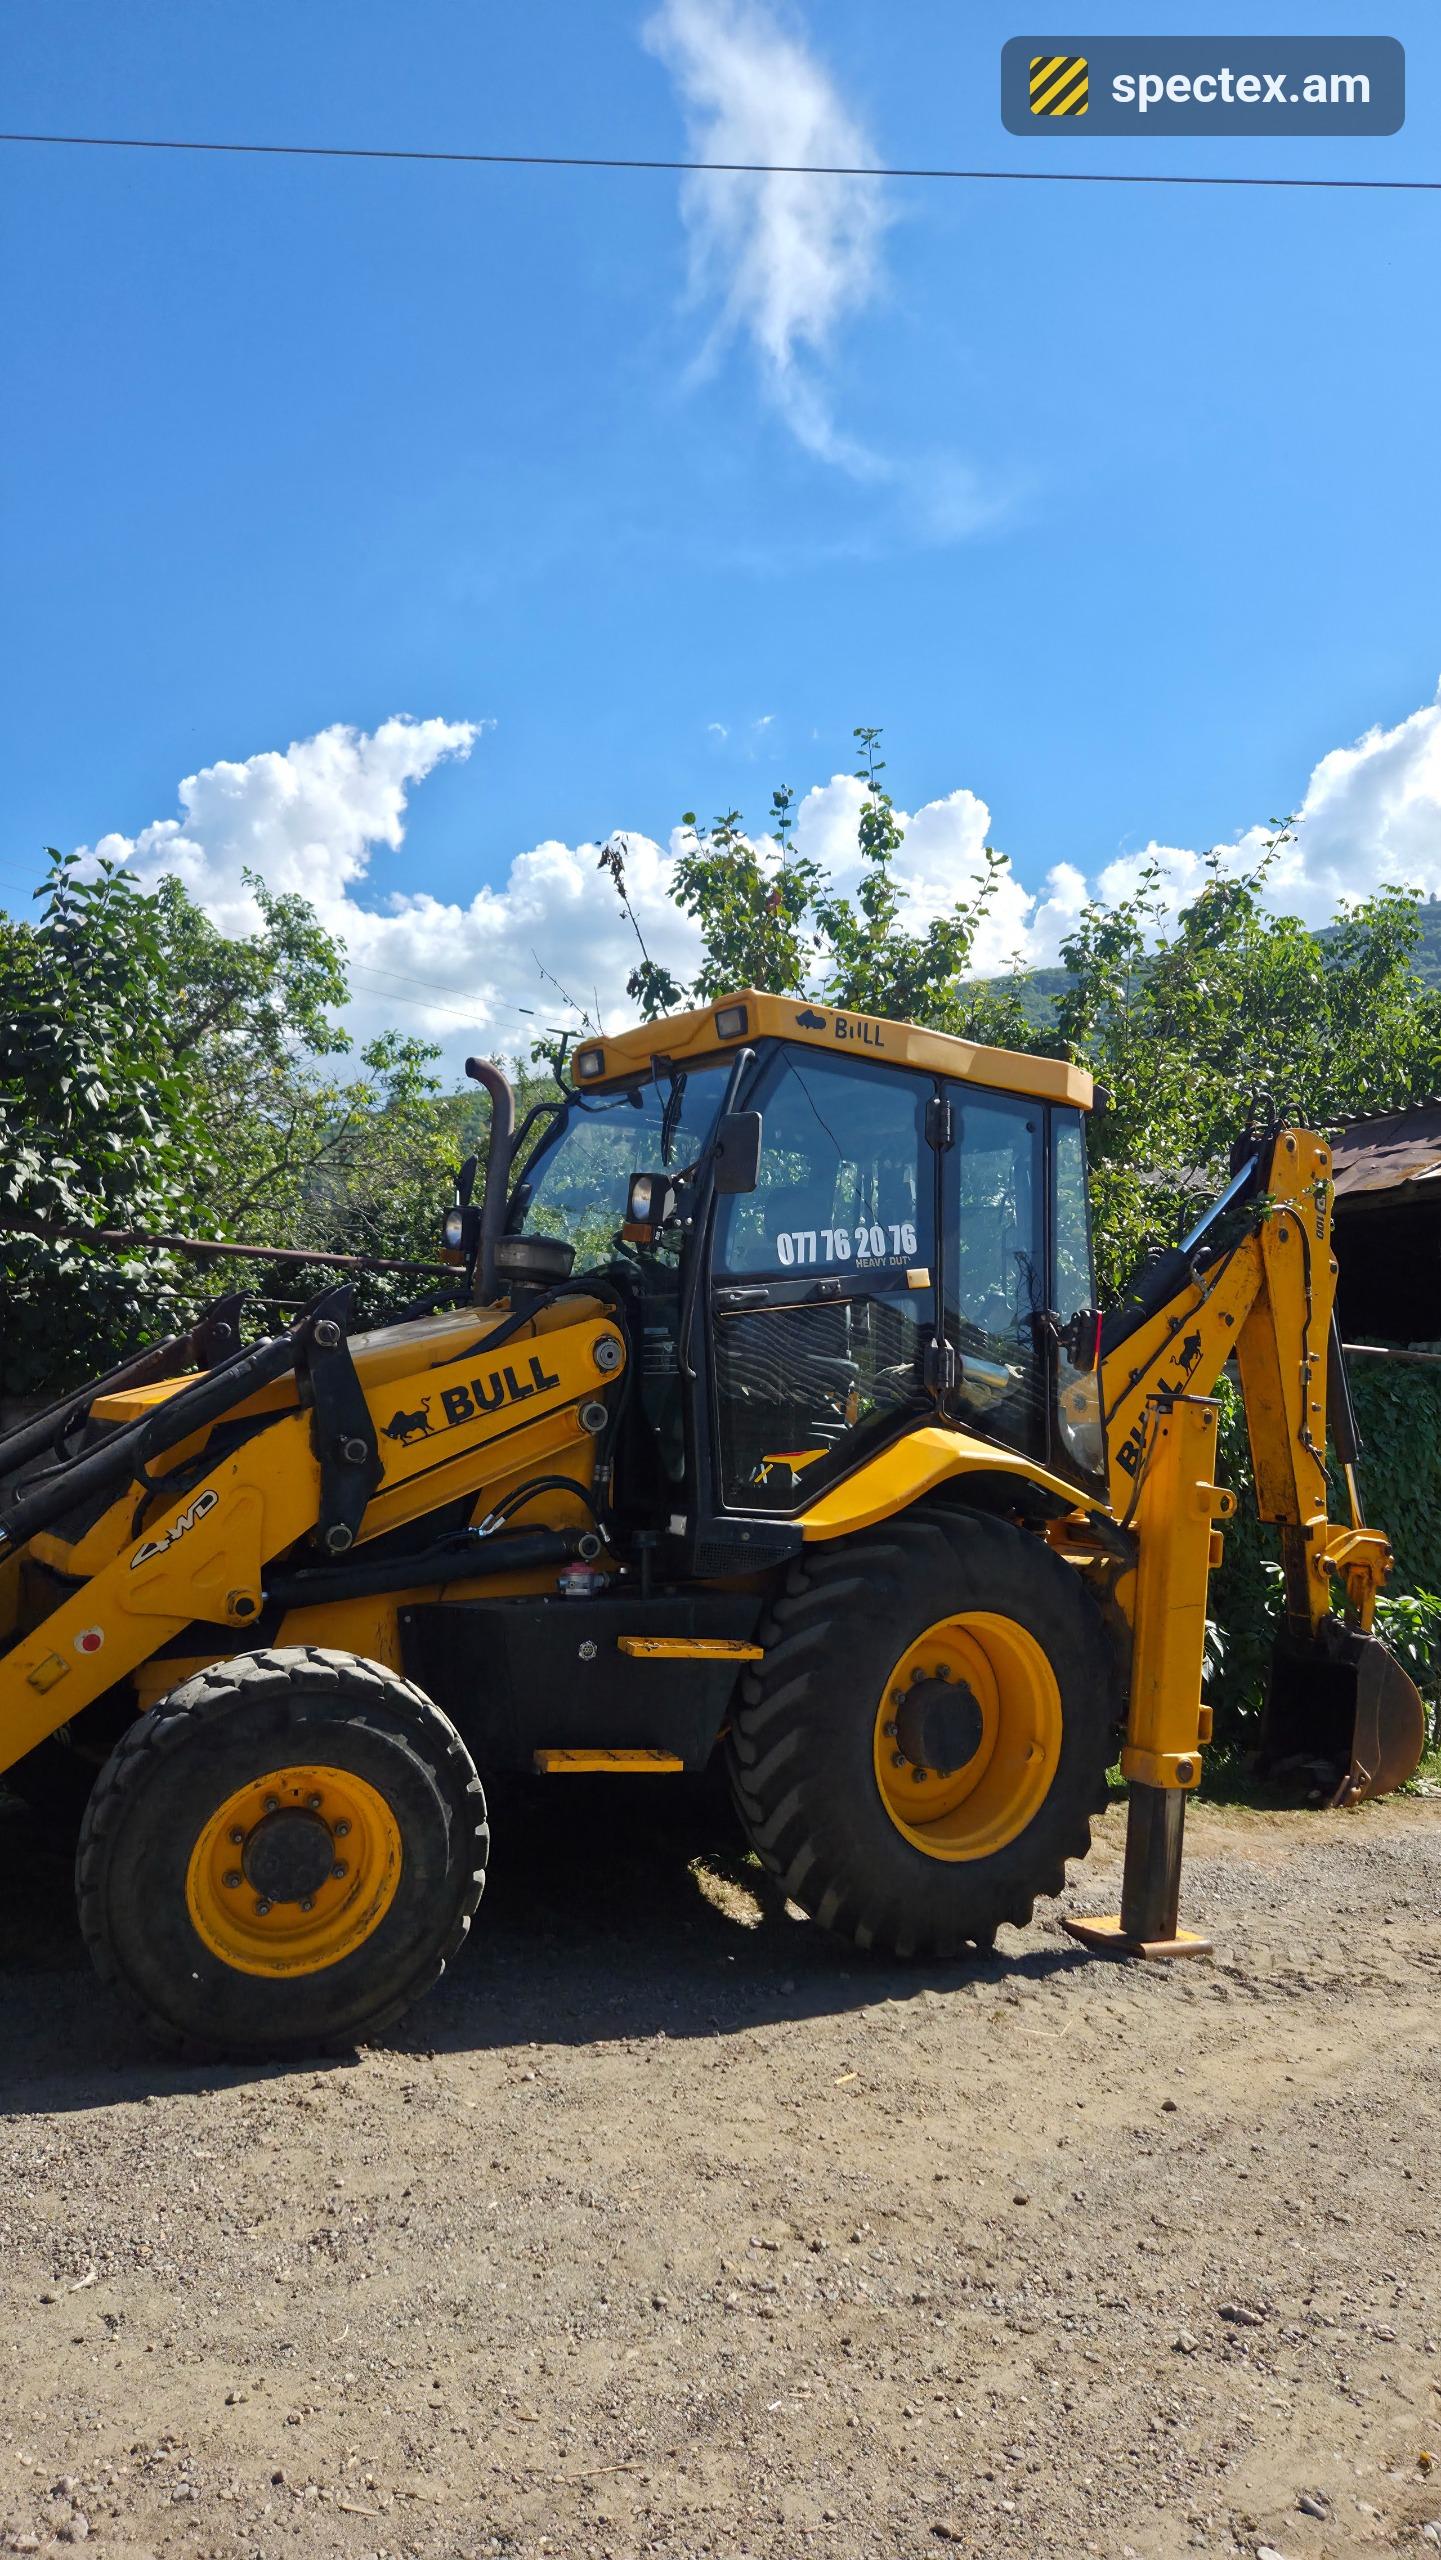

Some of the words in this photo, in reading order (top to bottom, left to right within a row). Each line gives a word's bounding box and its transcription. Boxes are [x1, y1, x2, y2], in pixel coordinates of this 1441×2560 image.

[776, 1230, 817, 1265] 077
[820, 1228, 851, 1261] 76
[854, 1225, 886, 1258] 20
[888, 1223, 918, 1255] 76
[855, 1257, 887, 1269] HEAVY
[889, 1255, 912, 1266] DUT
[440, 1356, 560, 1425] BULL
[1115, 1377, 1184, 1479] BL
[130, 1489, 219, 1570] 4WD
